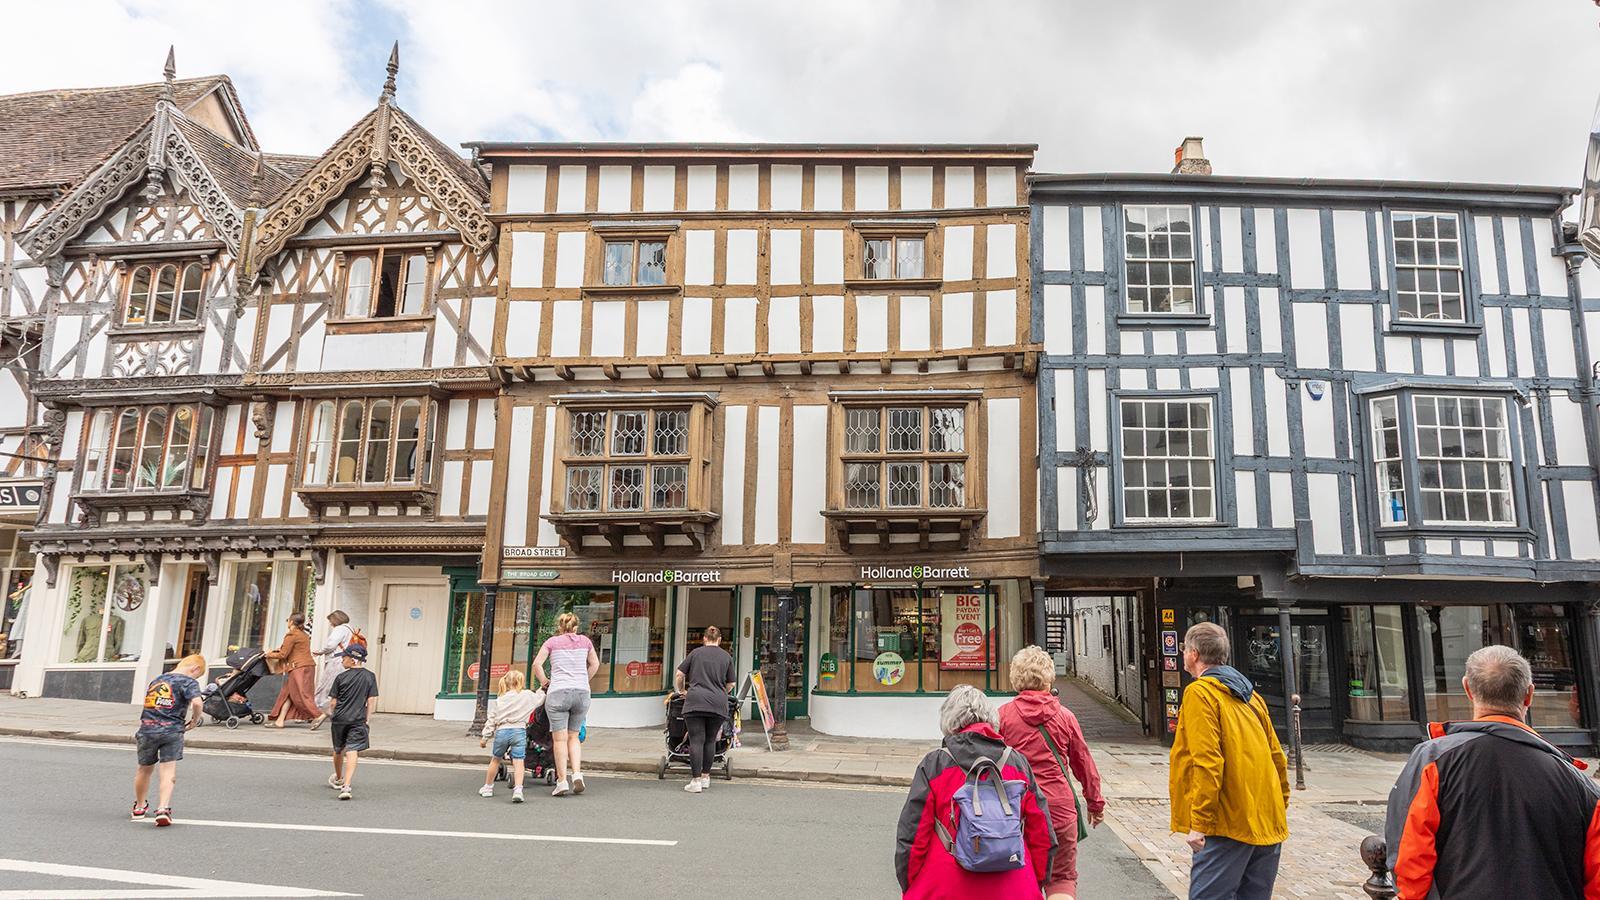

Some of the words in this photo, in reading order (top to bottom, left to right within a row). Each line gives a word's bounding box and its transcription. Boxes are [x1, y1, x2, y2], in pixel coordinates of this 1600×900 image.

[0, 489, 12, 503] S
[612, 569, 720, 583] Holland&Barrett
[861, 565, 969, 579] Holland&Barrett
[956, 596, 980, 606] BIG
[956, 633, 981, 644] Free
